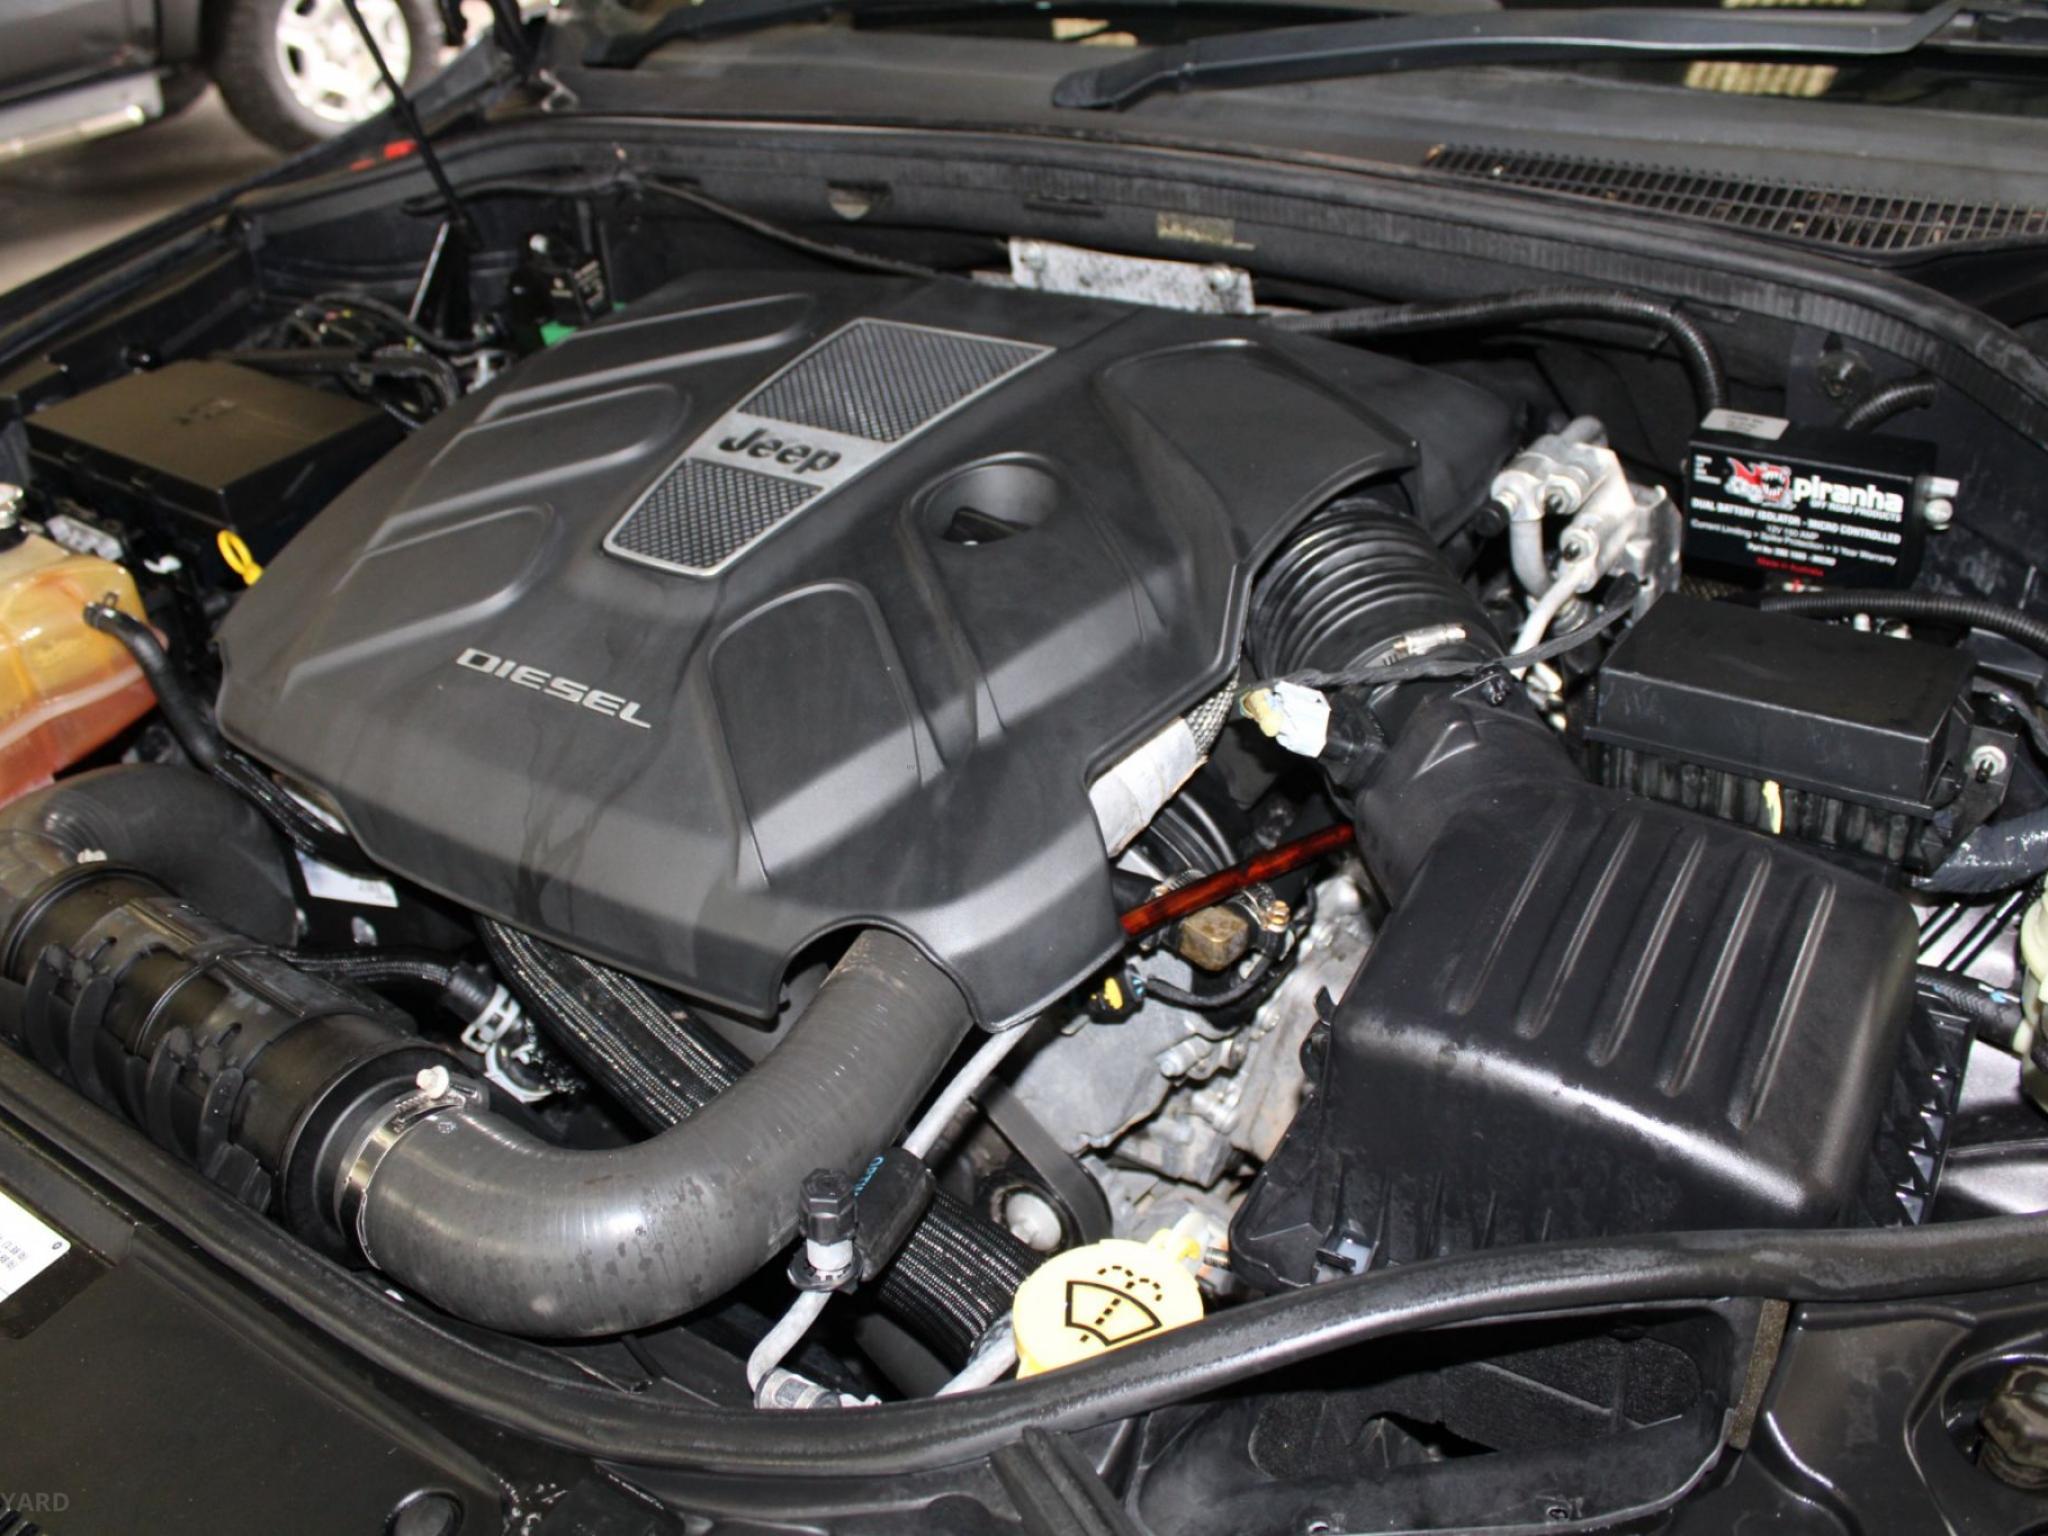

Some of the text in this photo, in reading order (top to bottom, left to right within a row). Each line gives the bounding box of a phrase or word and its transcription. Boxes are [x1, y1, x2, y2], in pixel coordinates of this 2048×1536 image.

[718, 427, 841, 474] Jeep
[1793, 475, 1904, 513] piranha
[1808, 499, 1902, 523] OFF ROAD PRODUCTS
[1691, 497, 1715, 511] DUAL
[1716, 502, 1755, 518] BATTERY
[1757, 510, 1801, 526] ISOLATOR
[1808, 518, 1839, 534] MICRO
[1840, 524, 1902, 545] CONTROLLED
[455, 647, 651, 729] DIESEL
